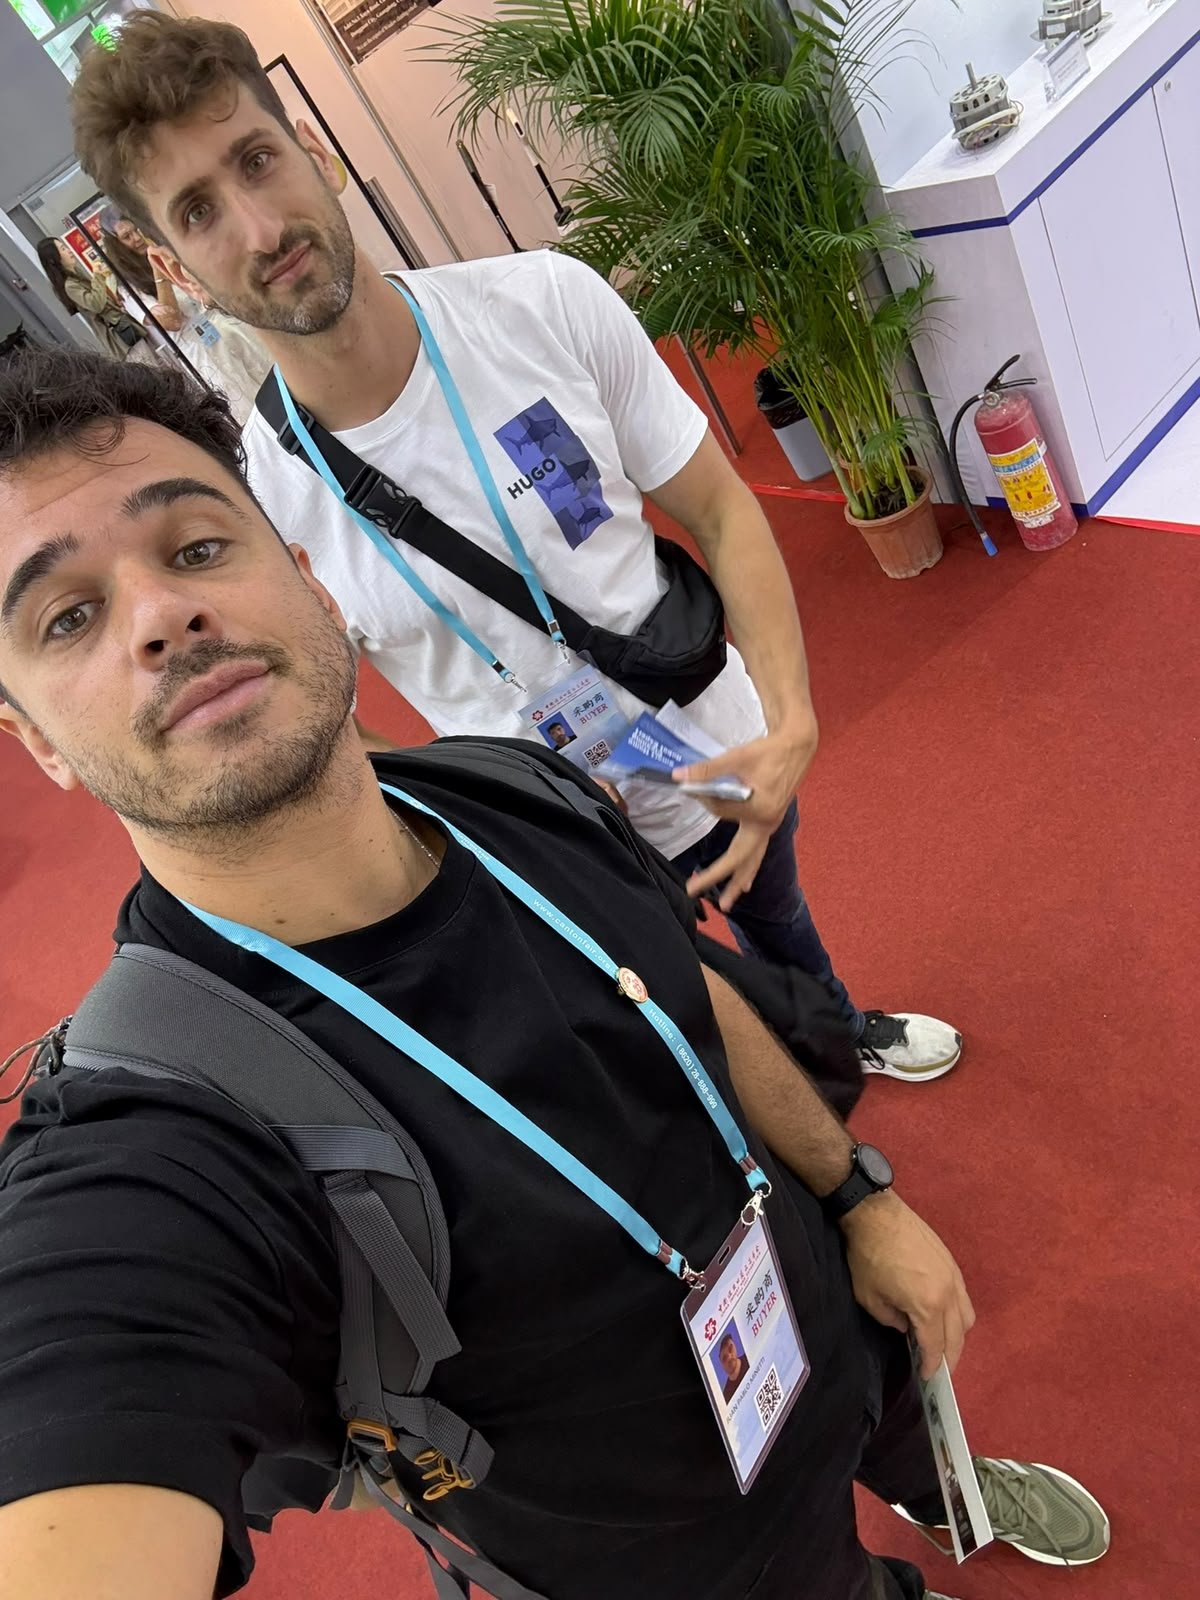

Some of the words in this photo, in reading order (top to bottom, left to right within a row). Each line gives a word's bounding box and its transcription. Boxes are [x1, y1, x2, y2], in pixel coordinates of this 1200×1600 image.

[507, 458, 556, 500] HUGO
[573, 691, 605, 717] 采购商
[580, 703, 608, 725] BUYER
[649, 1009, 676, 1041] Hotline:
[745, 1269, 773, 1325] 采购商
[751, 1290, 778, 1338] BUYER
